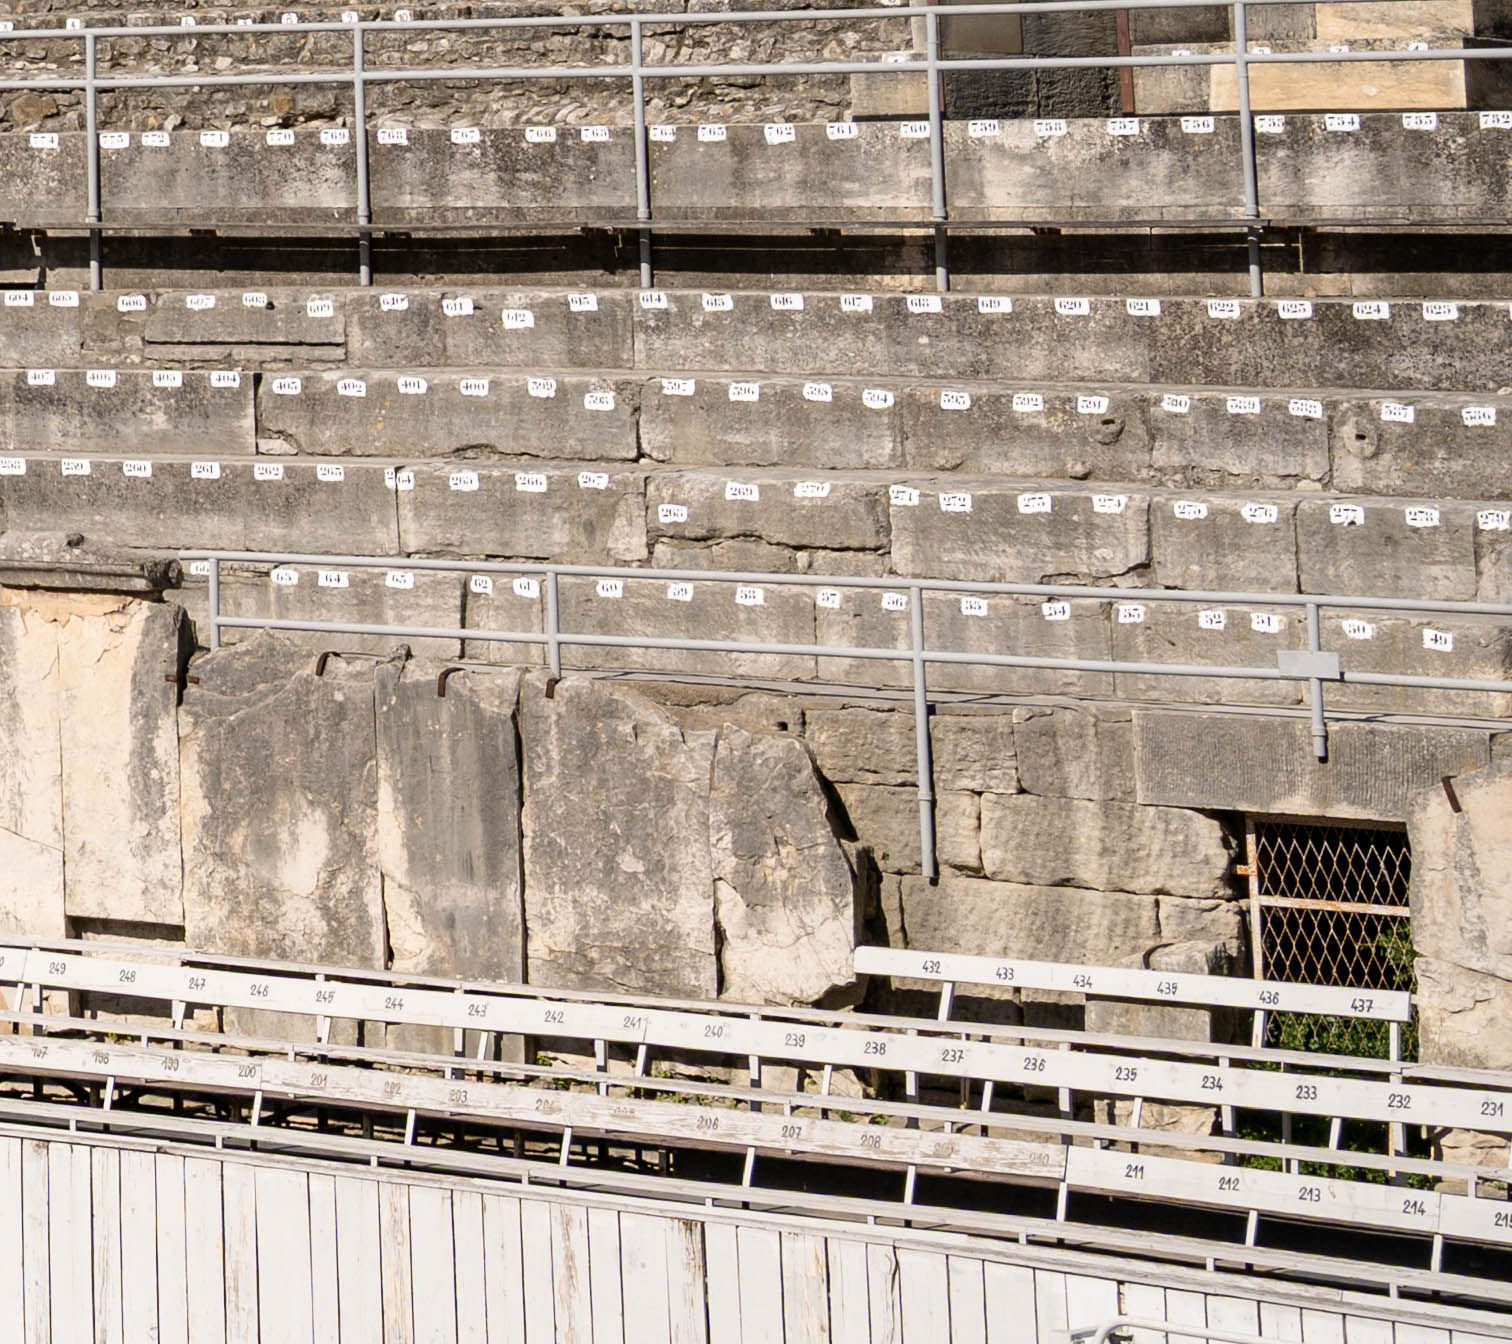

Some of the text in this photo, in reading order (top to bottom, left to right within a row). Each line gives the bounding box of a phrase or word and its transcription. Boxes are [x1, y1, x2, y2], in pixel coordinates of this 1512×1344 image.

[49, 962, 66, 974] 249
[923, 960, 941, 974] 432
[996, 967, 1014, 980] 433
[120, 969, 136, 982] 248
[1073, 975, 1092, 988] 434
[189, 977, 206, 990] 247
[251, 984, 269, 997] 246
[1157, 982, 1177, 995] 435
[316, 991, 335, 1003] 245
[385, 997, 403, 1010] 244
[1259, 991, 1279, 1005] 436
[468, 1004, 487, 1017] 243
[1351, 998, 1374, 1013] 437
[544, 1010, 564, 1023] 242
[624, 1016, 641, 1029] 241
[705, 1025, 723, 1038] 240
[785, 1033, 805, 1048] 239
[864, 1041, 886, 1055] 238
[942, 1049, 964, 1063] 237
[239, 1063, 259, 1078] 200
[1024, 1057, 1046, 1072] 236
[1115, 1066, 1137, 1082] 235
[1201, 1075, 1223, 1091] 234
[1296, 1085, 1317, 1100] 233
[1388, 1093, 1411, 1109] 232
[1480, 1101, 1503, 1117] 231
[697, 1116, 719, 1130] 206
[781, 1125, 802, 1139] 207
[860, 1135, 882, 1150] 208
[1125, 1164, 1144, 1179] 211
[1219, 1177, 1239, 1191] 212
[1298, 1187, 1320, 1202] 213
[1402, 1200, 1426, 1216] 214
